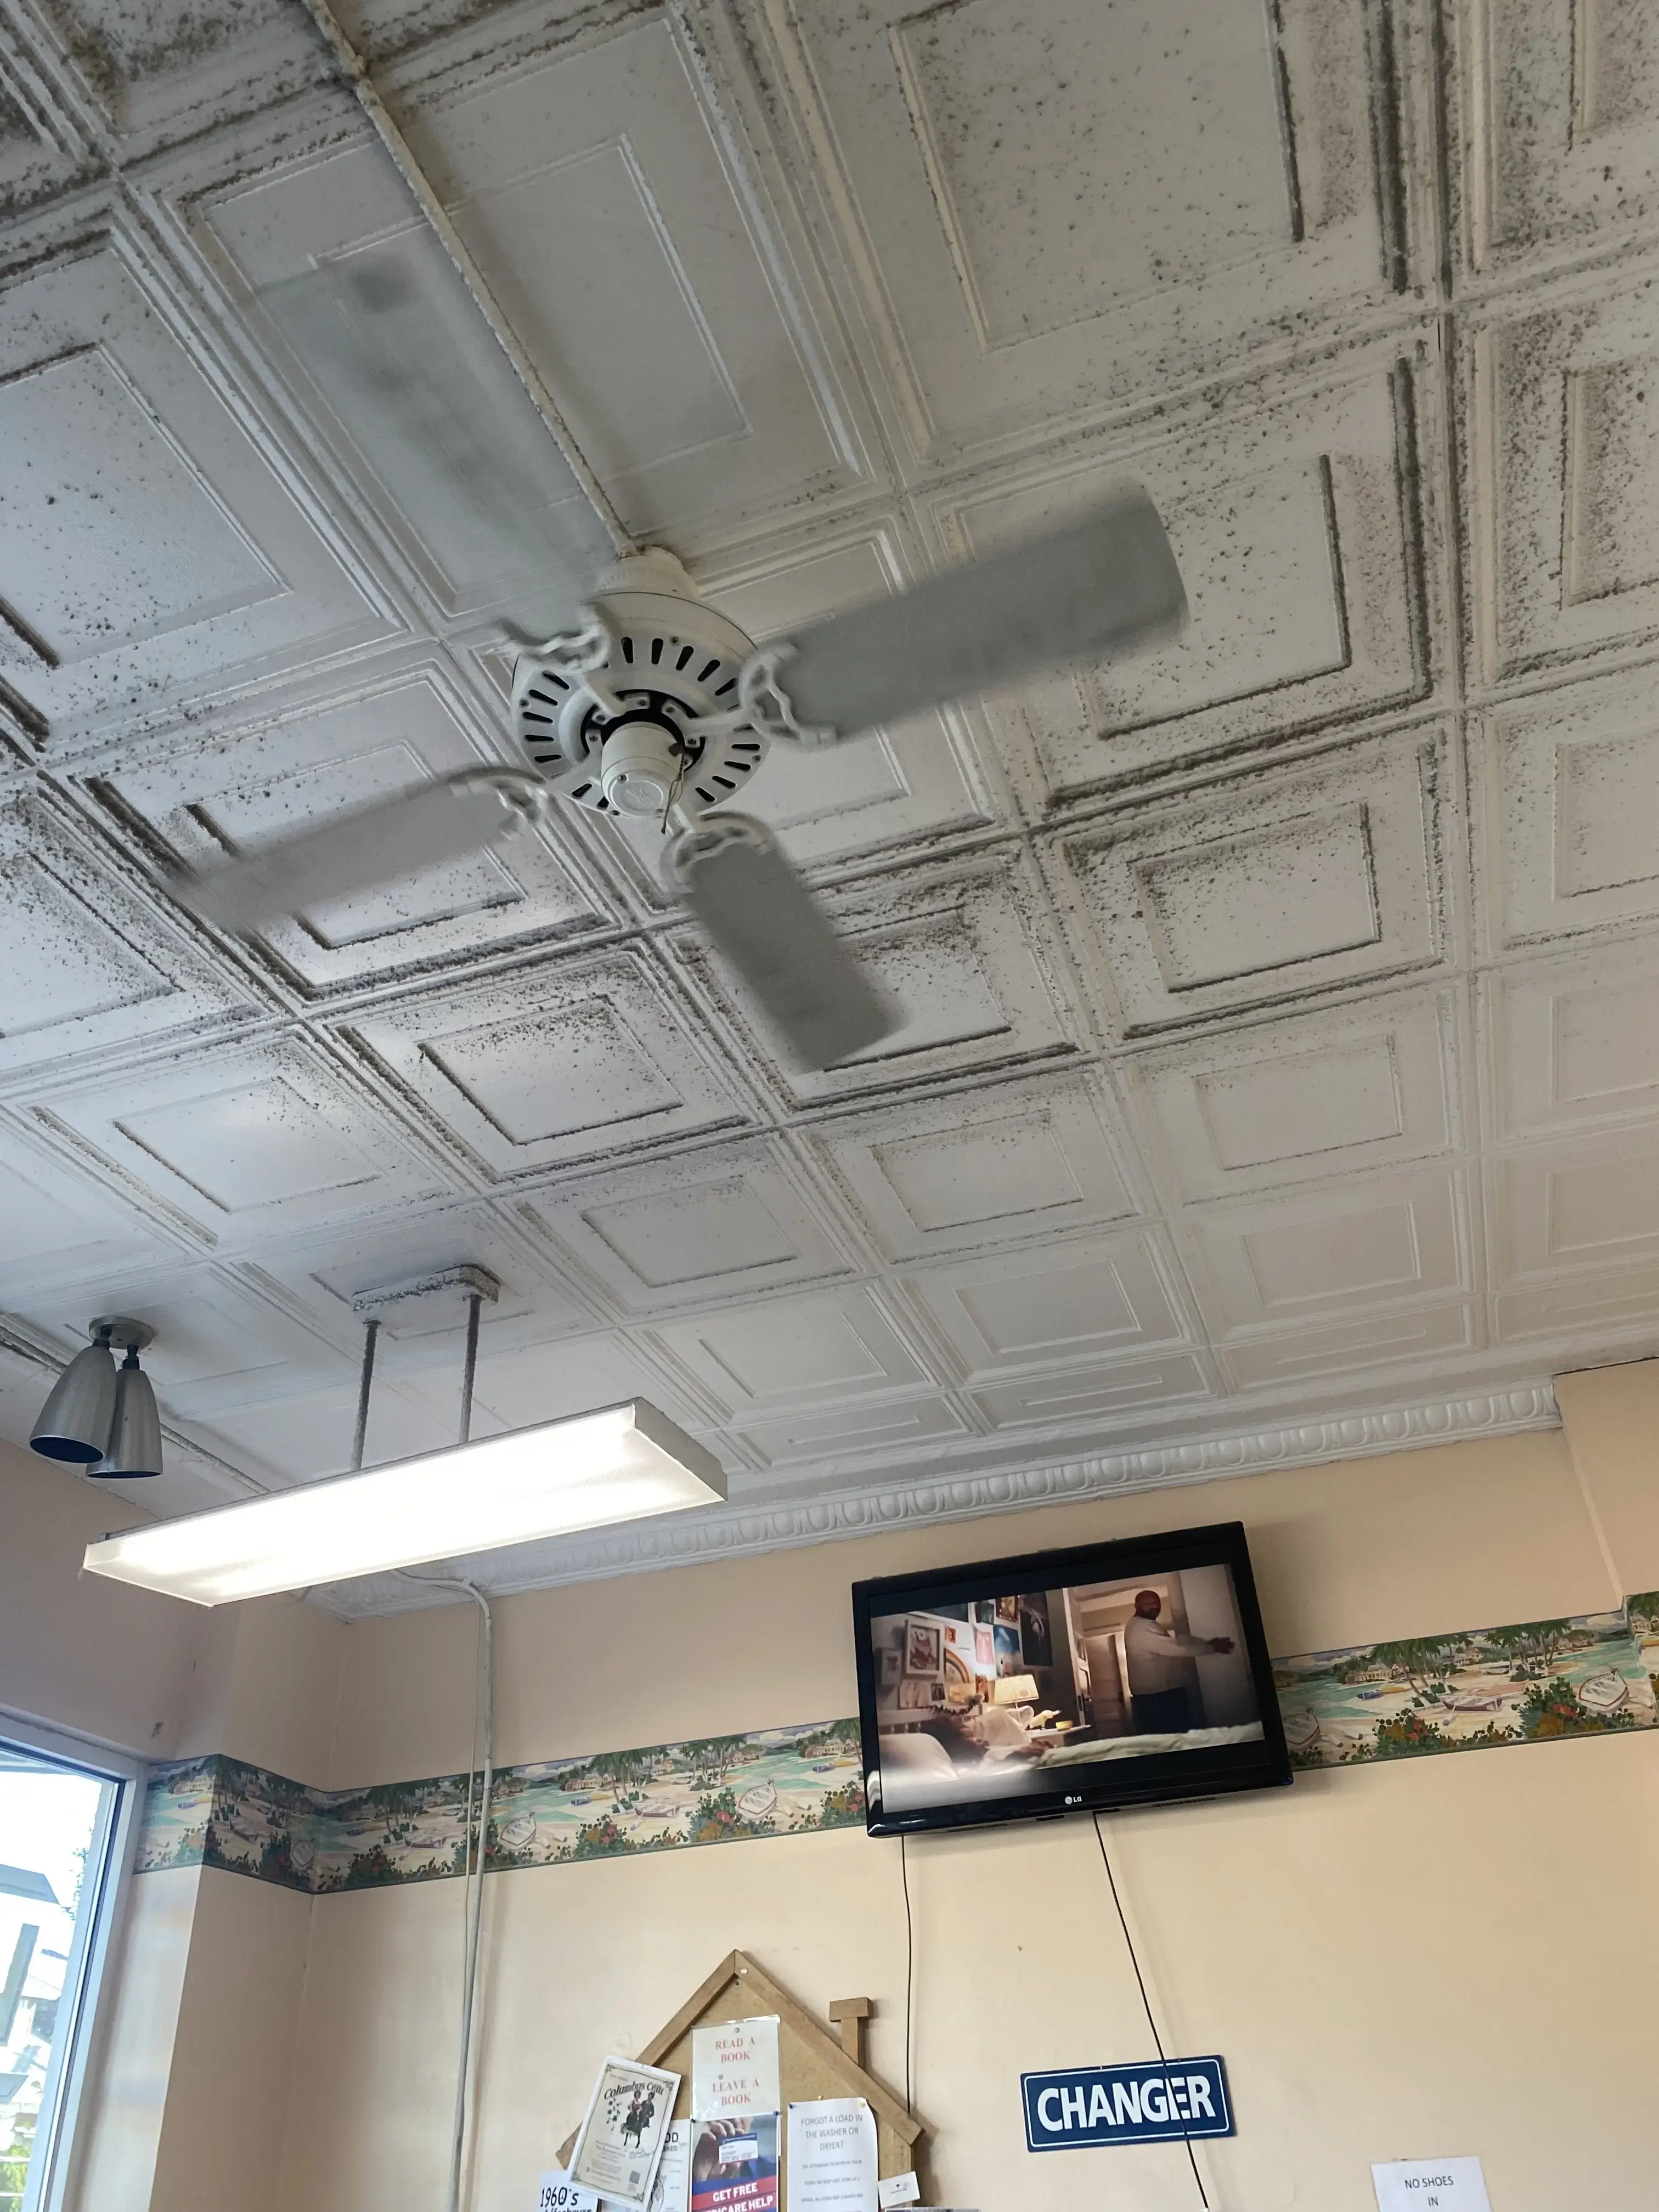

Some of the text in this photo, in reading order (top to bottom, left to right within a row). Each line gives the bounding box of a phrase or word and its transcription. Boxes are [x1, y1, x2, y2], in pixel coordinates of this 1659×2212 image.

[715, 2036, 755, 2050] READ A
[721, 2051, 751, 2063] BOOK
[604, 2080, 645, 2100] Columbus
[712, 2078, 759, 2092] LEAVE A
[721, 2093, 751, 2106] BOOK
[1037, 2075, 1216, 2131] CHANGER
[801, 2115, 827, 2126] FORGOT
[835, 2114, 854, 2123] LOAD
[855, 2114, 863, 2122] IN
[805, 2127, 859, 2139] THE WASHER OR
[820, 2141, 844, 2151] DRYER?
[1404, 2176, 1454, 2189] NO SHOES
[540, 2186, 579, 2208] 1960's
[713, 2182, 758, 2202] GET FREE
[748, 2196, 774, 2210] HELP
[1427, 2197, 1439, 2207] IN
